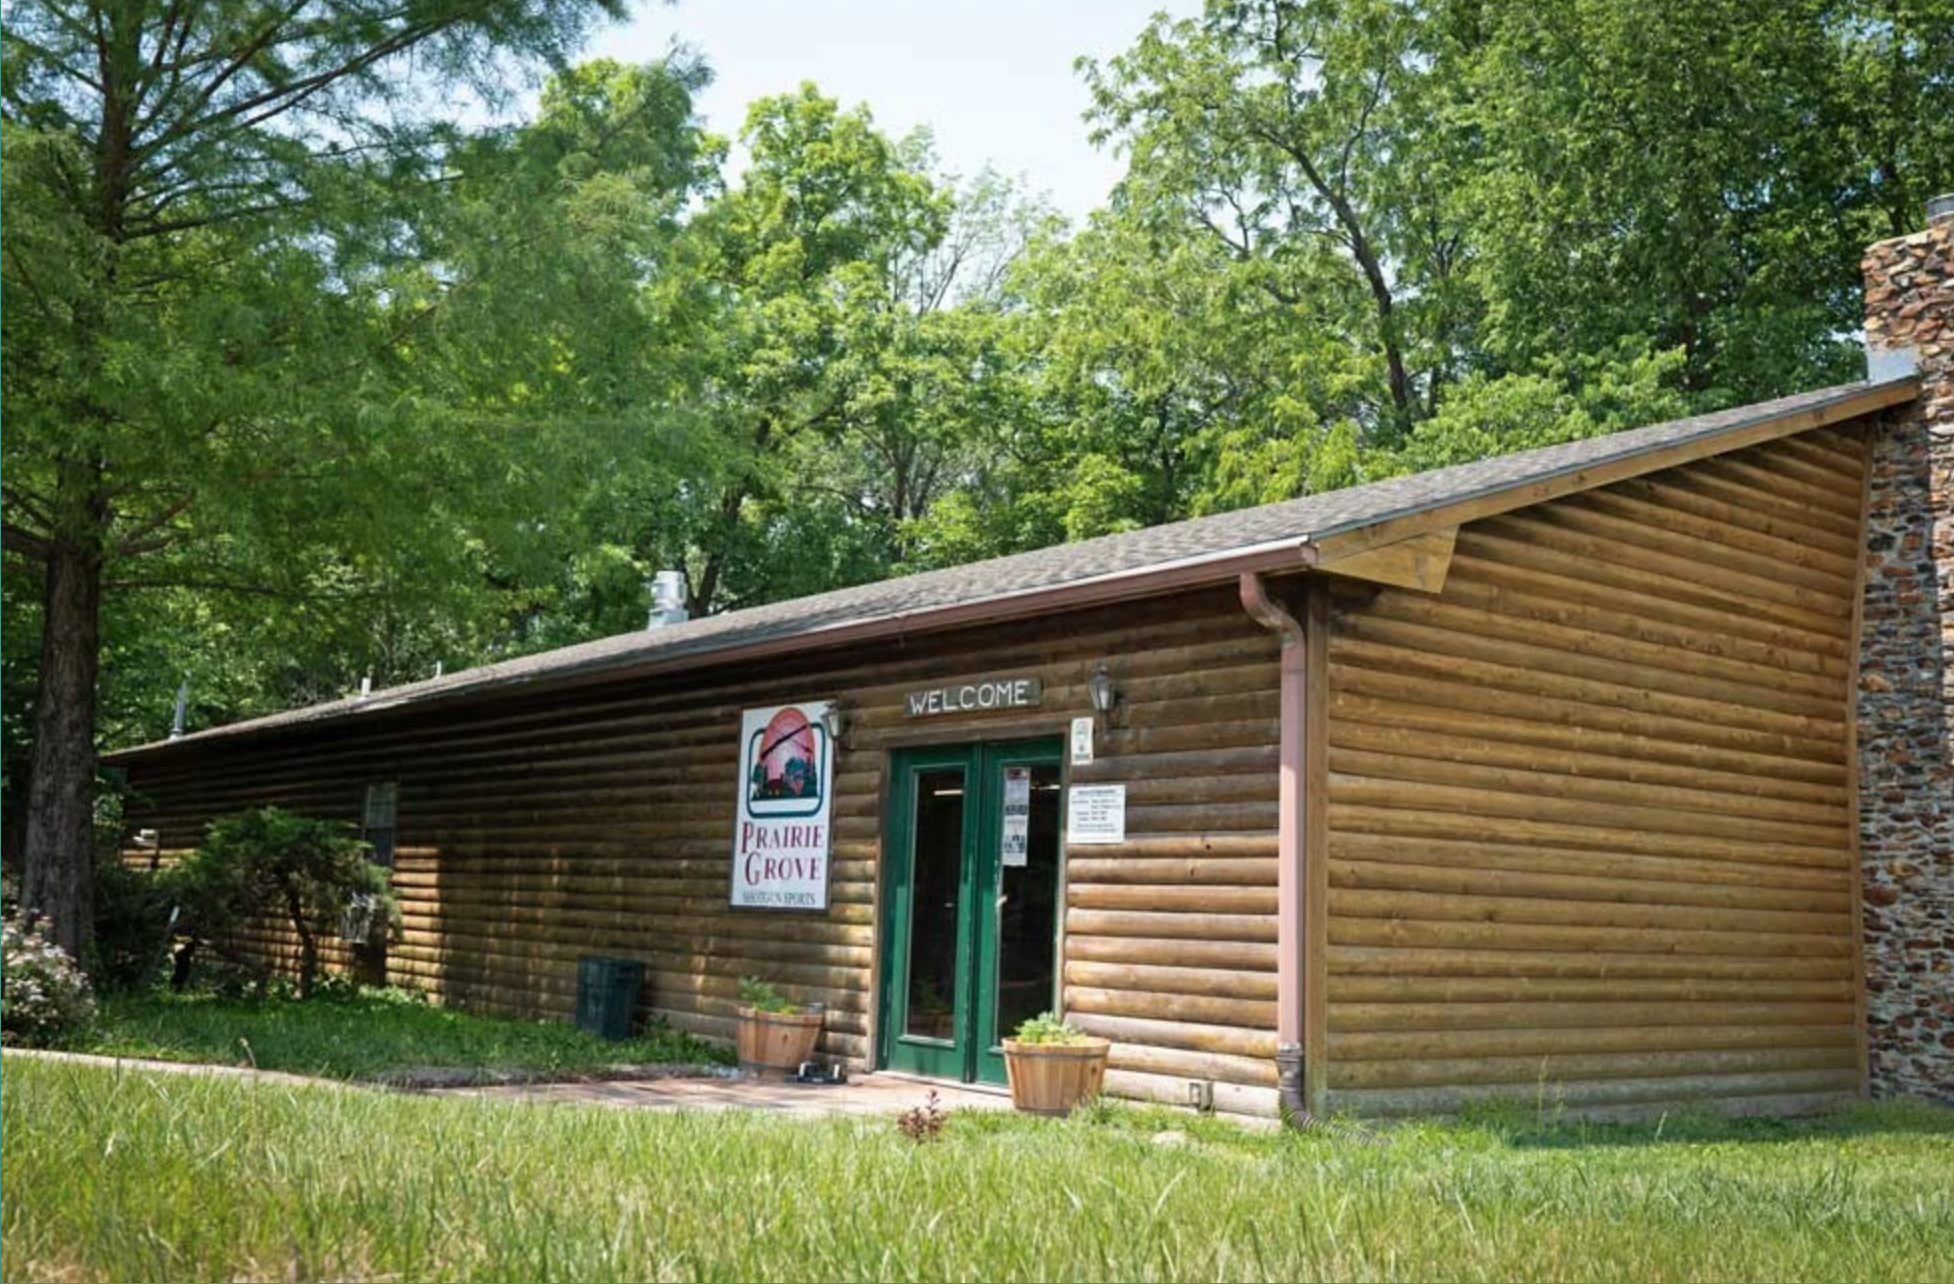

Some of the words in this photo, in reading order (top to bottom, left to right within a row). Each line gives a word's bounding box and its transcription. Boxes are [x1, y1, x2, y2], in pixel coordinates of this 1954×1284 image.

[910, 680, 1030, 715] WELCOME
[742, 821, 824, 854] PRAIRIE
[745, 851, 822, 886] GROVE
[742, 891, 782, 904] SHOTGUN
[784, 892, 816, 906] SPORTS
